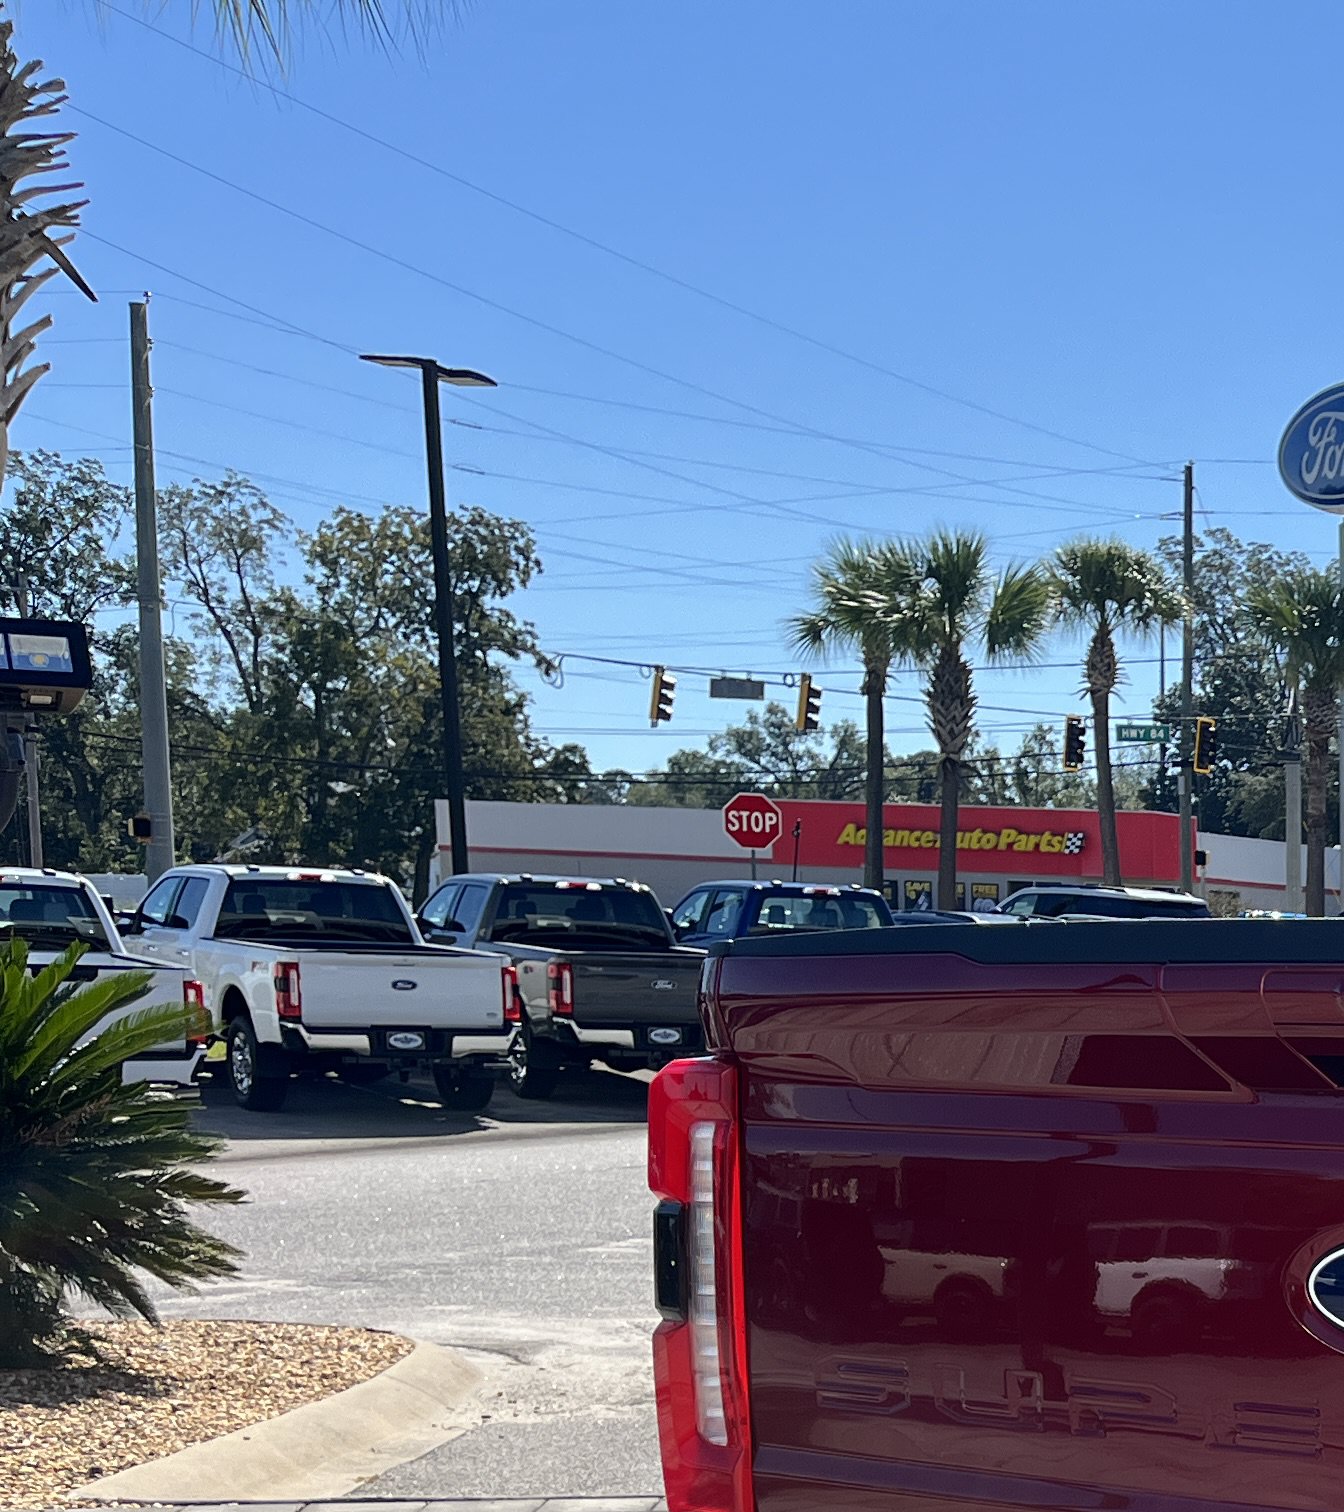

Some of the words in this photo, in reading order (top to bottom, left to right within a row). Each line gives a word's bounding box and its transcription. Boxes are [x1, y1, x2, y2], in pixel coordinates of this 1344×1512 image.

[1121, 728, 1145, 739] HWY
[727, 809, 778, 833] STOP
[837, 823, 938, 848] Adance
[937, 828, 998, 850] uto
[998, 828, 1063, 853] Parts
